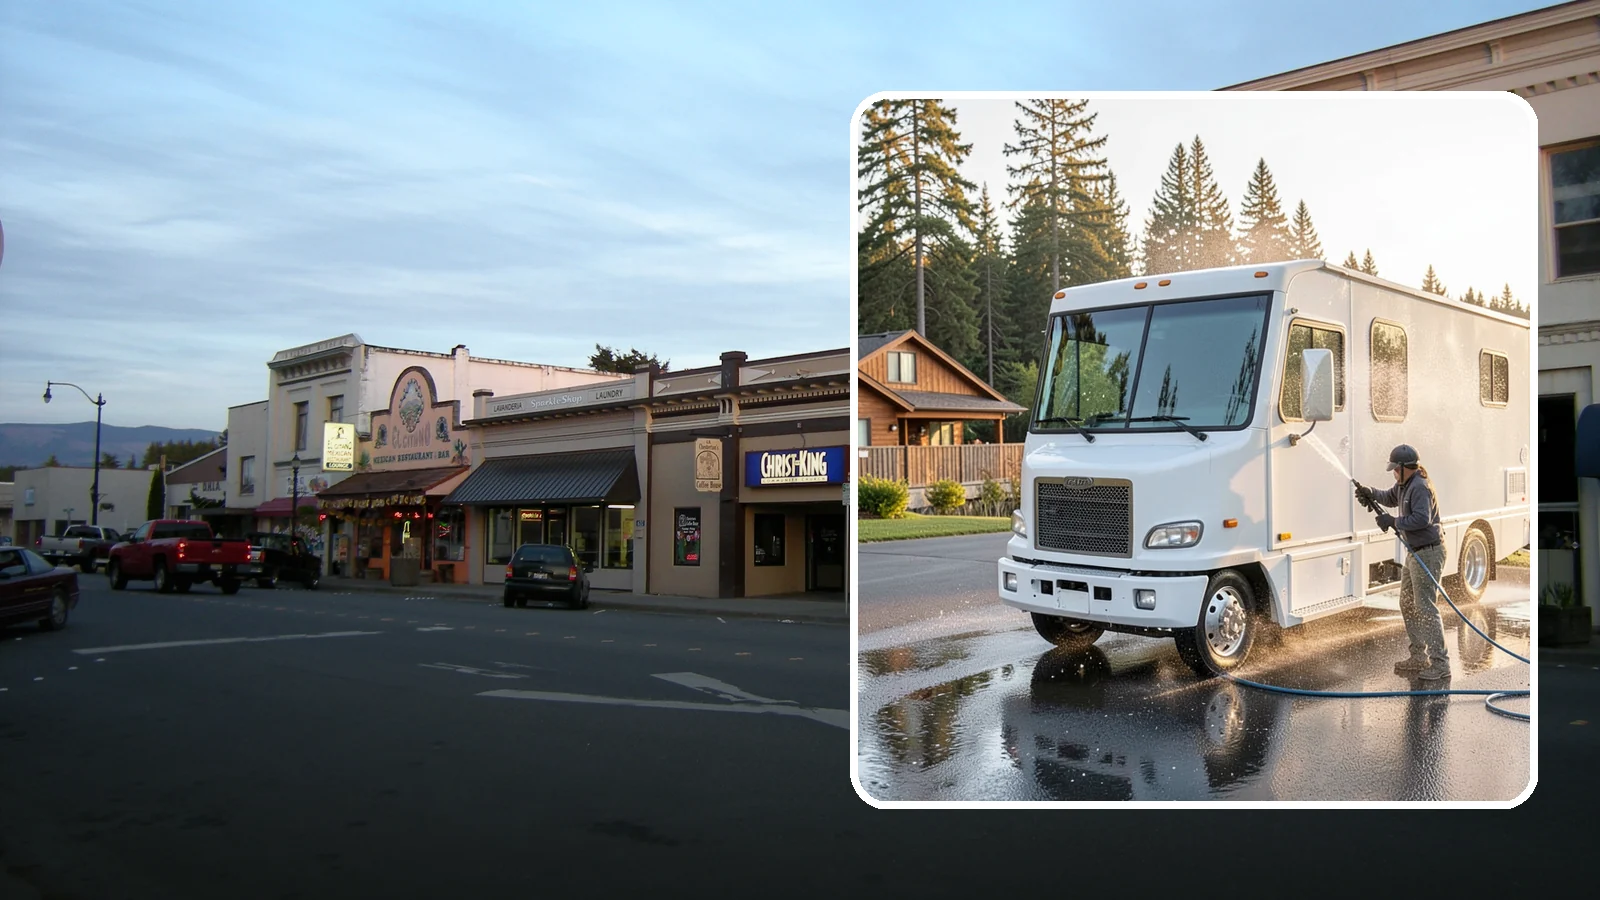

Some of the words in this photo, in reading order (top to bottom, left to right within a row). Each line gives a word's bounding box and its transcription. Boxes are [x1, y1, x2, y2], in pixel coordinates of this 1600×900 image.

[596, 389, 623, 400] LAUNDRY
[493, 402, 522, 413] LAVANDERIA
[531, 397, 561, 409] Sparkle
[561, 395, 583, 405] Shop
[373, 455, 396, 464] MEXICAN
[397, 452, 434, 462] RESTAURANT
[437, 450, 450, 459] BAR
[760, 452, 797, 478] CHRIST
[799, 450, 827, 477] KING
[696, 481, 709, 489] Coffee
